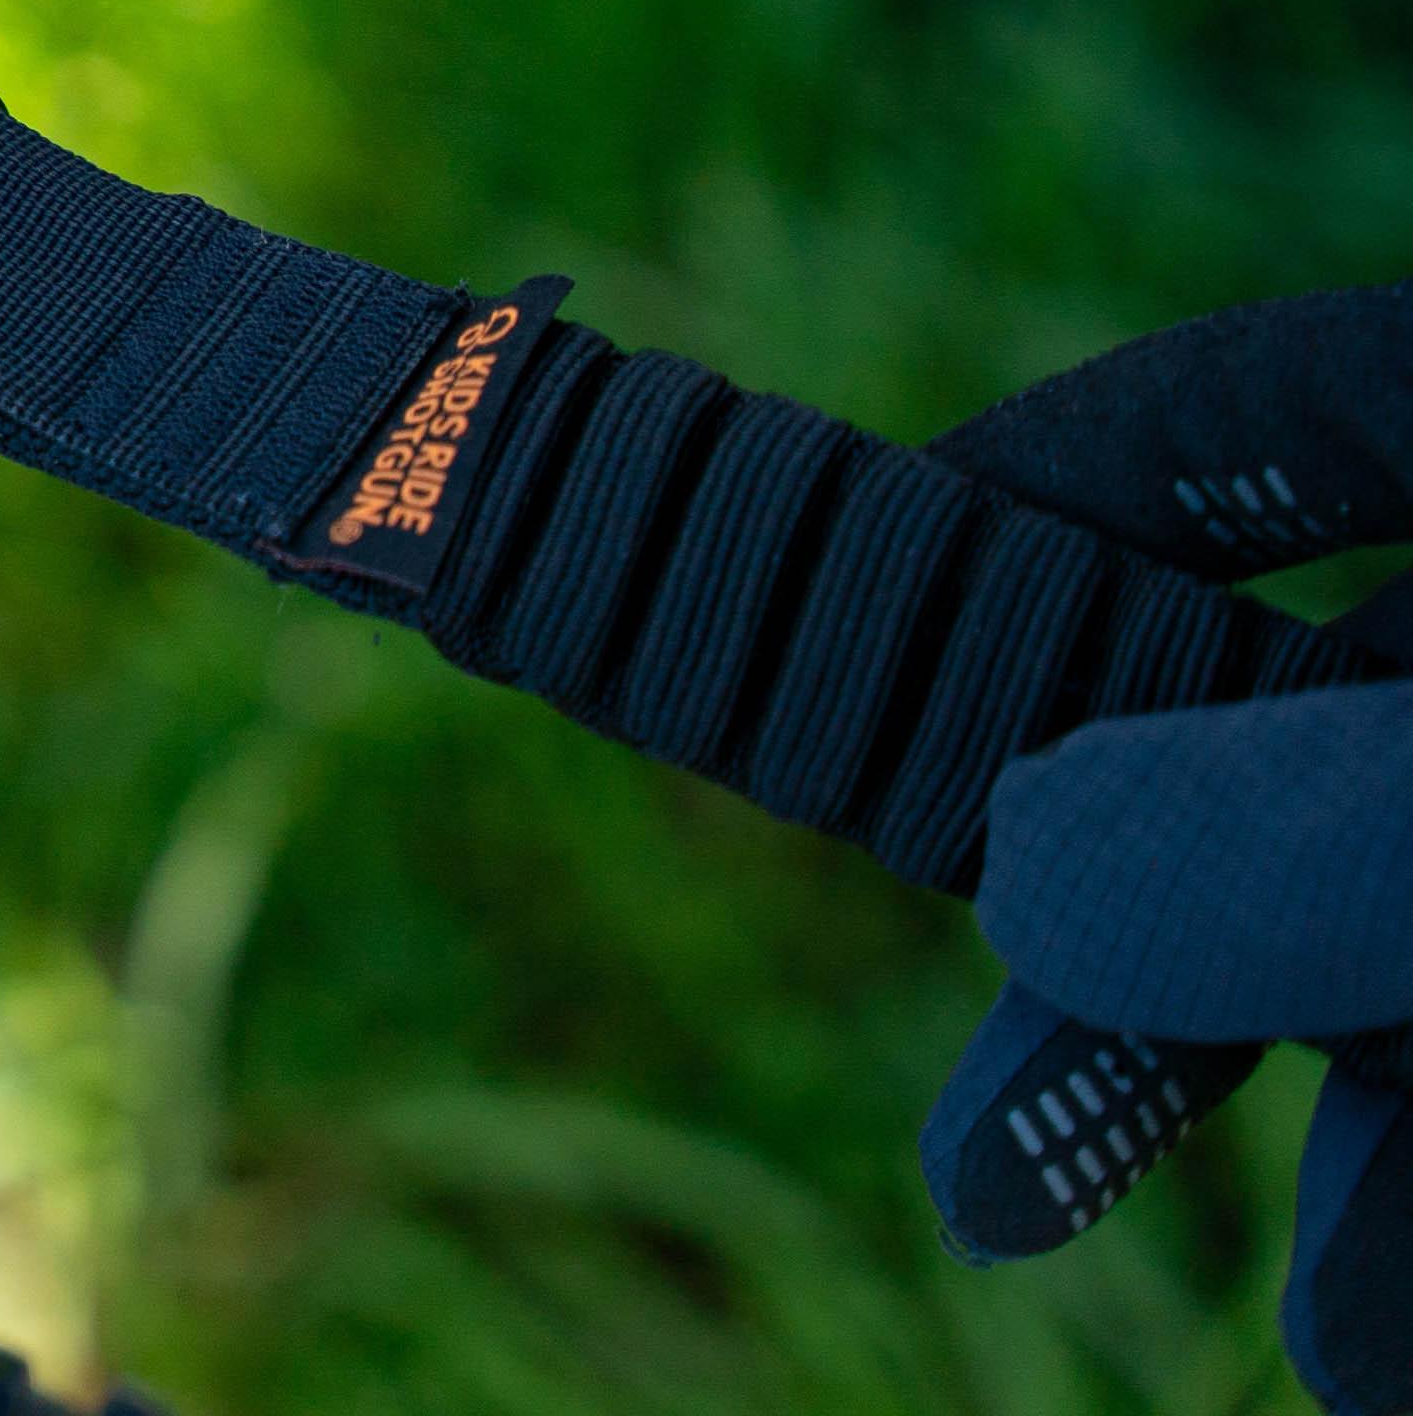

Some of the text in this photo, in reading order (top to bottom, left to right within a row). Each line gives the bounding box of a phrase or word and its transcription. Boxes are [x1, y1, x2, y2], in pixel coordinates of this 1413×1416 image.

[353, 359, 458, 528] SHOTGUN
[386, 352, 498, 536] KIDS RIDE
